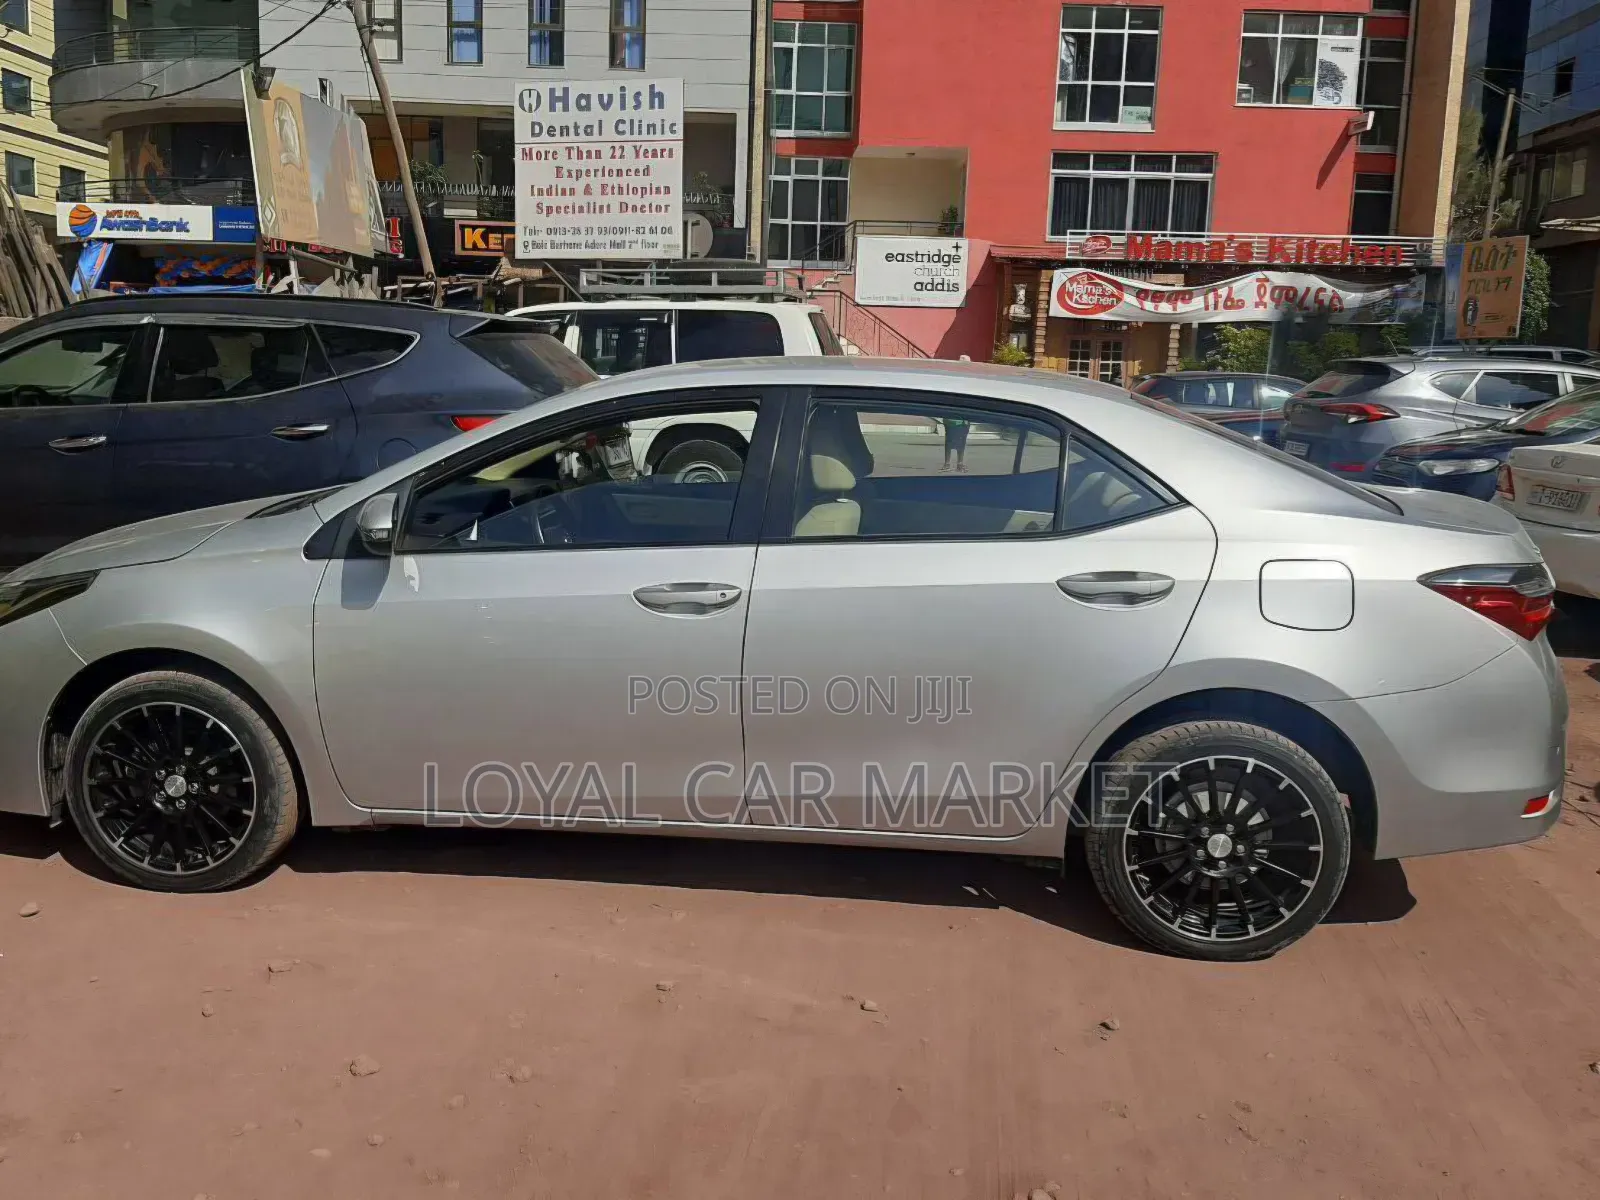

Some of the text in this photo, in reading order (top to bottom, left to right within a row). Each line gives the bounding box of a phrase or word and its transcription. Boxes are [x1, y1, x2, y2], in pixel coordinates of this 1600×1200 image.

[548, 84, 665, 113] Havish
[530, 118, 677, 138] Dental Clinic
[521, 144, 674, 161] More Than 22 Years
[554, 164, 651, 181] Experienced
[530, 182, 671, 198] Indian & Ethiopian
[535, 201, 671, 217] Specialist Doctor
[885, 248, 962, 267] eastridge
[1126, 234, 1253, 262] Mama's
[1267, 237, 1404, 265] Kitchen
[914, 265, 960, 277] church
[913, 278, 960, 293] addis
[1065, 279, 1112, 297] Mama's
